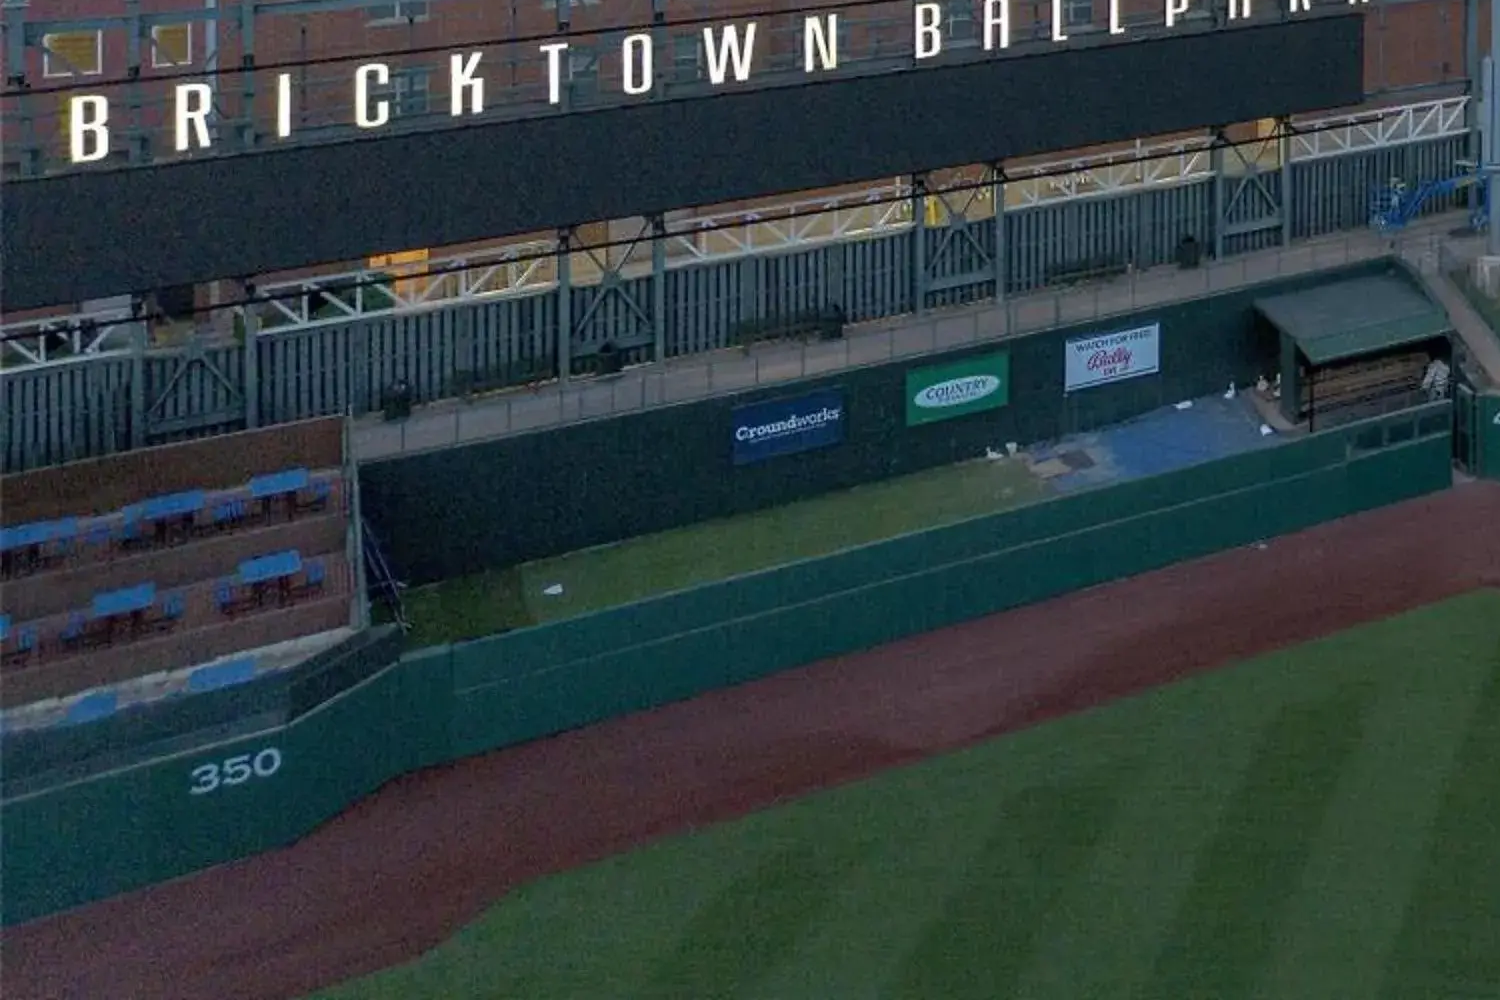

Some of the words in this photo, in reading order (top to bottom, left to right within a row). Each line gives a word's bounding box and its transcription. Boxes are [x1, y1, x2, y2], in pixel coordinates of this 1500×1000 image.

[67, 12, 838, 163] BRICKTOWN
[926, 377, 989, 401] COUNTRY
[735, 407, 840, 441] Groundworks
[190, 747, 282, 795] 350
